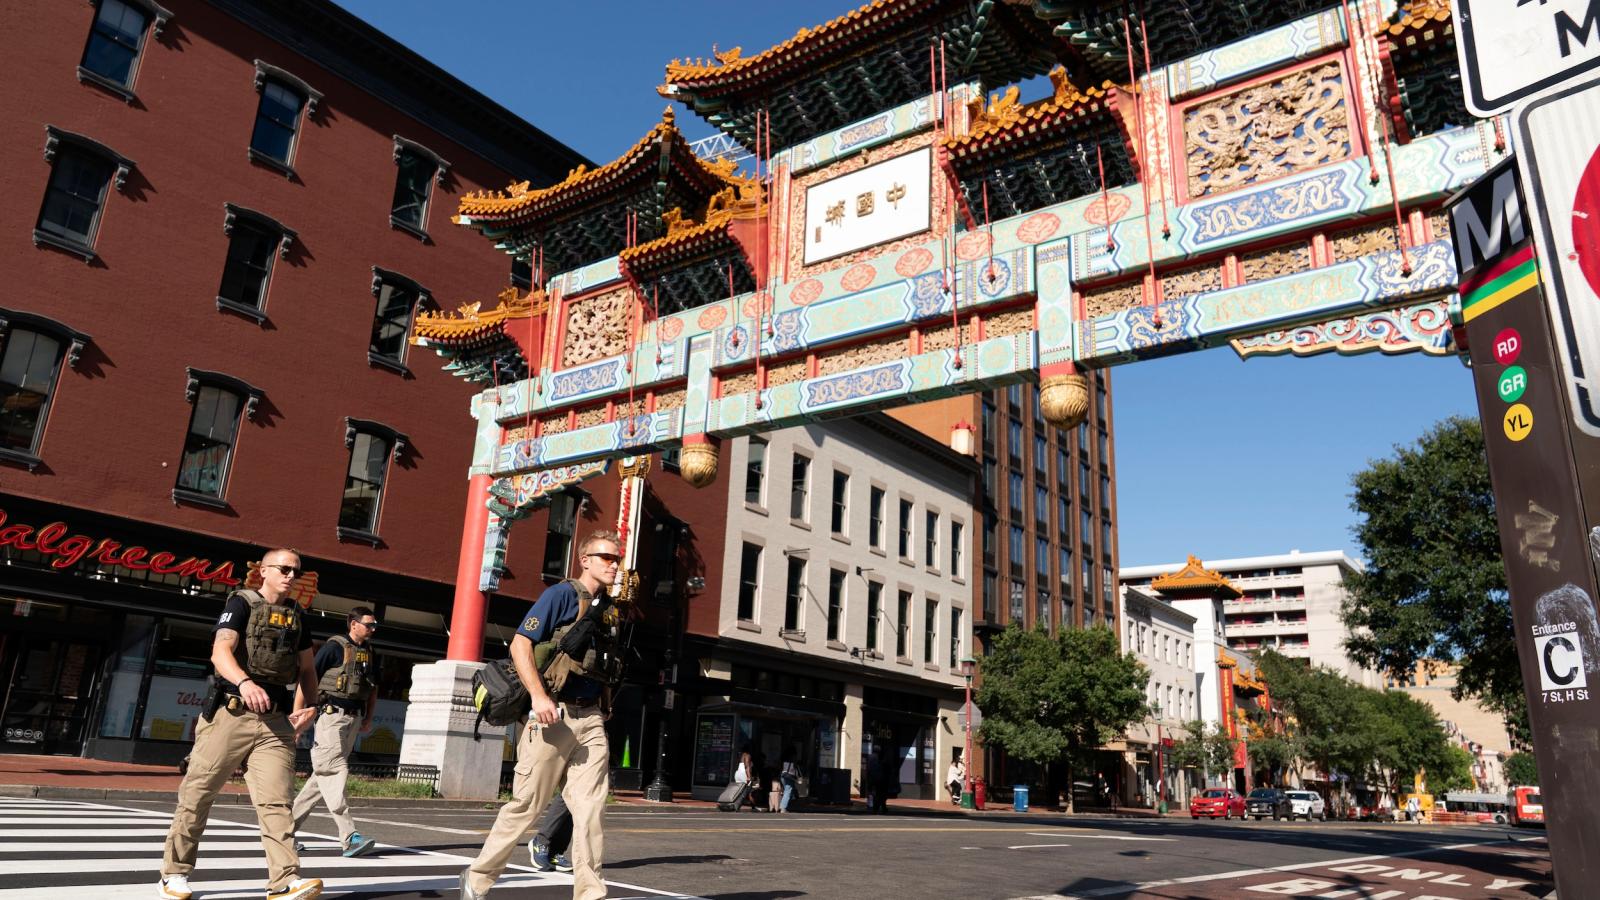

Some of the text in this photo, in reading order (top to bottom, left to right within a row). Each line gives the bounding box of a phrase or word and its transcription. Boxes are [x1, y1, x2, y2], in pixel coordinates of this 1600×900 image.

[1451, 168, 1525, 275] M
[1496, 336, 1517, 357] RD
[1500, 373, 1524, 395] GR
[1506, 414, 1529, 432] YL
[0, 511, 242, 586] algreens
[1531, 621, 1577, 636] Entrance
[355, 652, 369, 662] FBI
[1543, 637, 1579, 686] C
[1541, 689, 1590, 703] 7 St, H St
[1327, 863, 1538, 889] ONLY
[1240, 878, 1466, 900] BU
